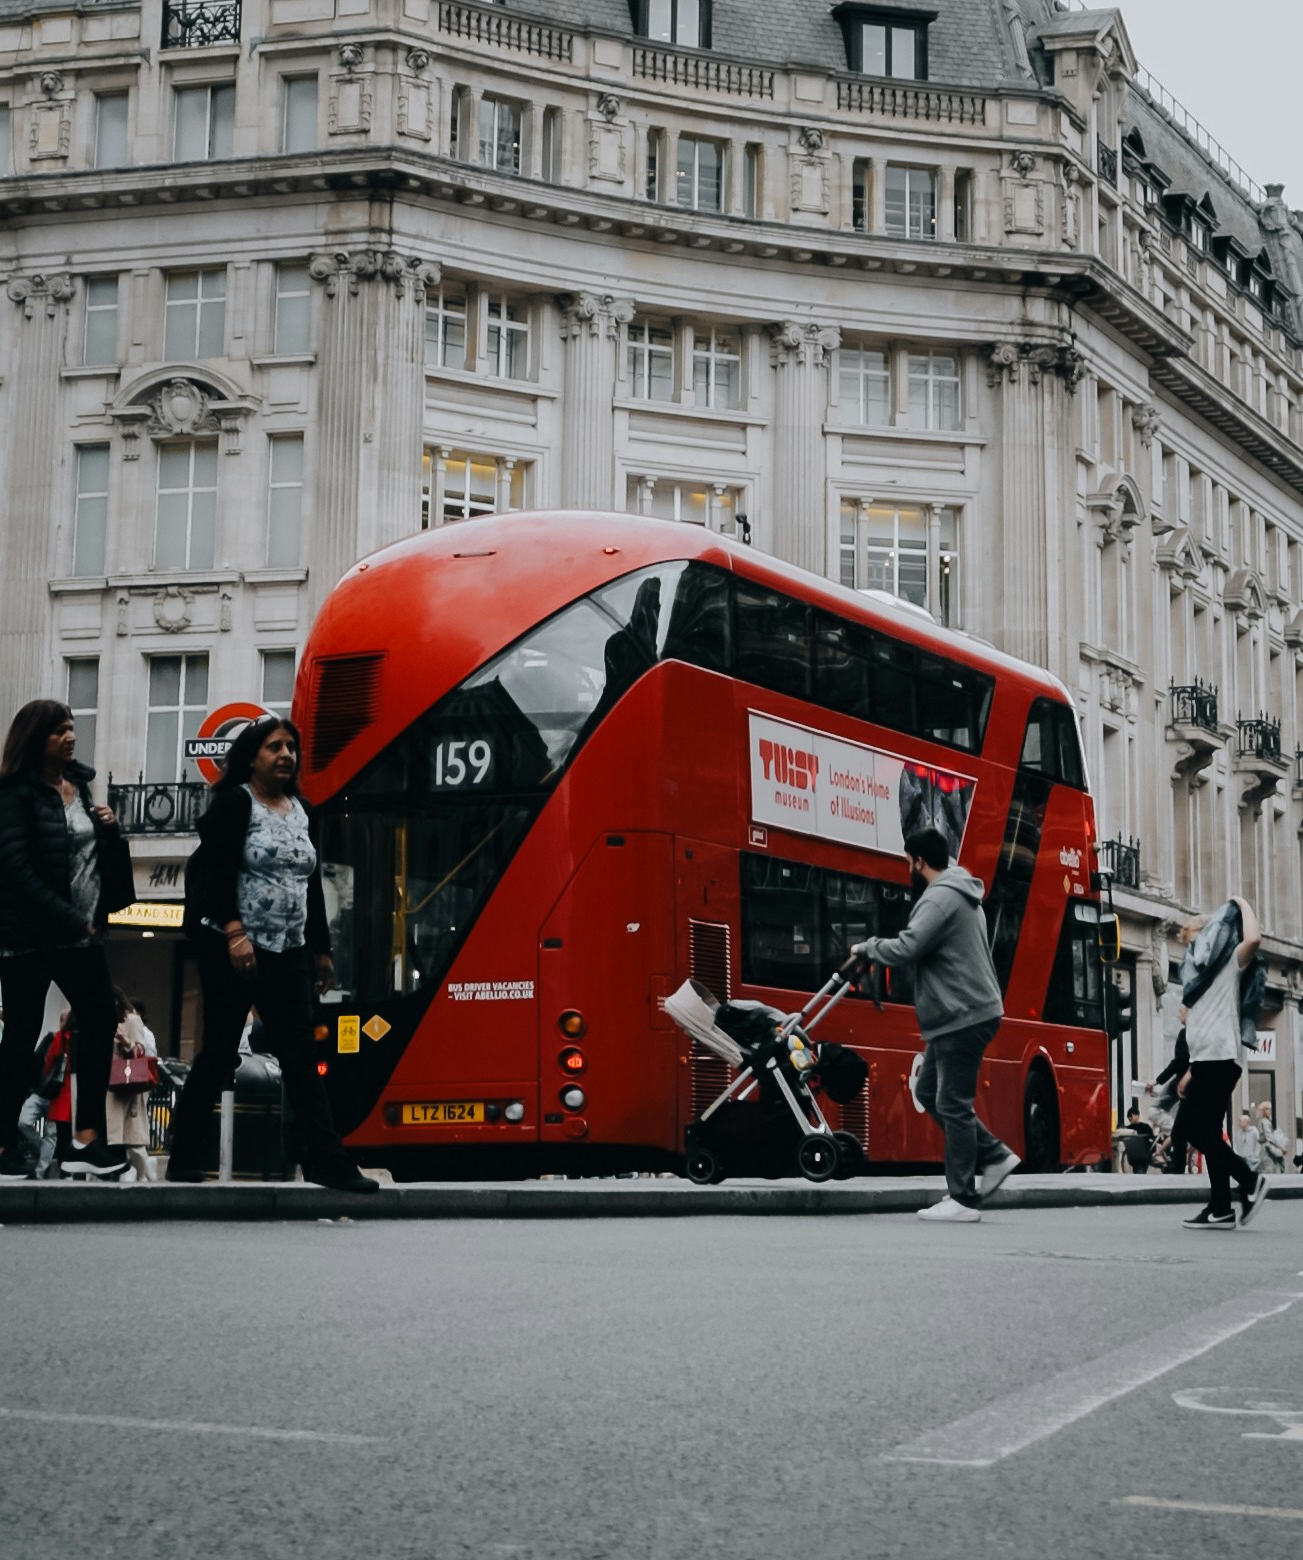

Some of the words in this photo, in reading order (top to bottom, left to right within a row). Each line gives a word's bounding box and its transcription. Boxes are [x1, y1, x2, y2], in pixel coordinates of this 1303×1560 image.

[188, 742, 233, 754] UNDER
[436, 740, 491, 785] 159
[828, 764, 866, 794] London's
[867, 776, 890, 800] Home
[775, 790, 810, 812] museum
[830, 796, 839, 816] of
[841, 798, 875, 825] Illusions
[149, 864, 182, 887] H&M
[448, 983, 463, 992] BUS
[464, 982, 491, 991] DRIVER
[492, 981, 534, 990] VACANCIES
[454, 991, 473, 1000] VISIT
[475, 990, 534, 1000] ABELLIO.CO.UK
[411, 1106, 440, 1121] LTZ
[443, 1105, 475, 1121] 1624
